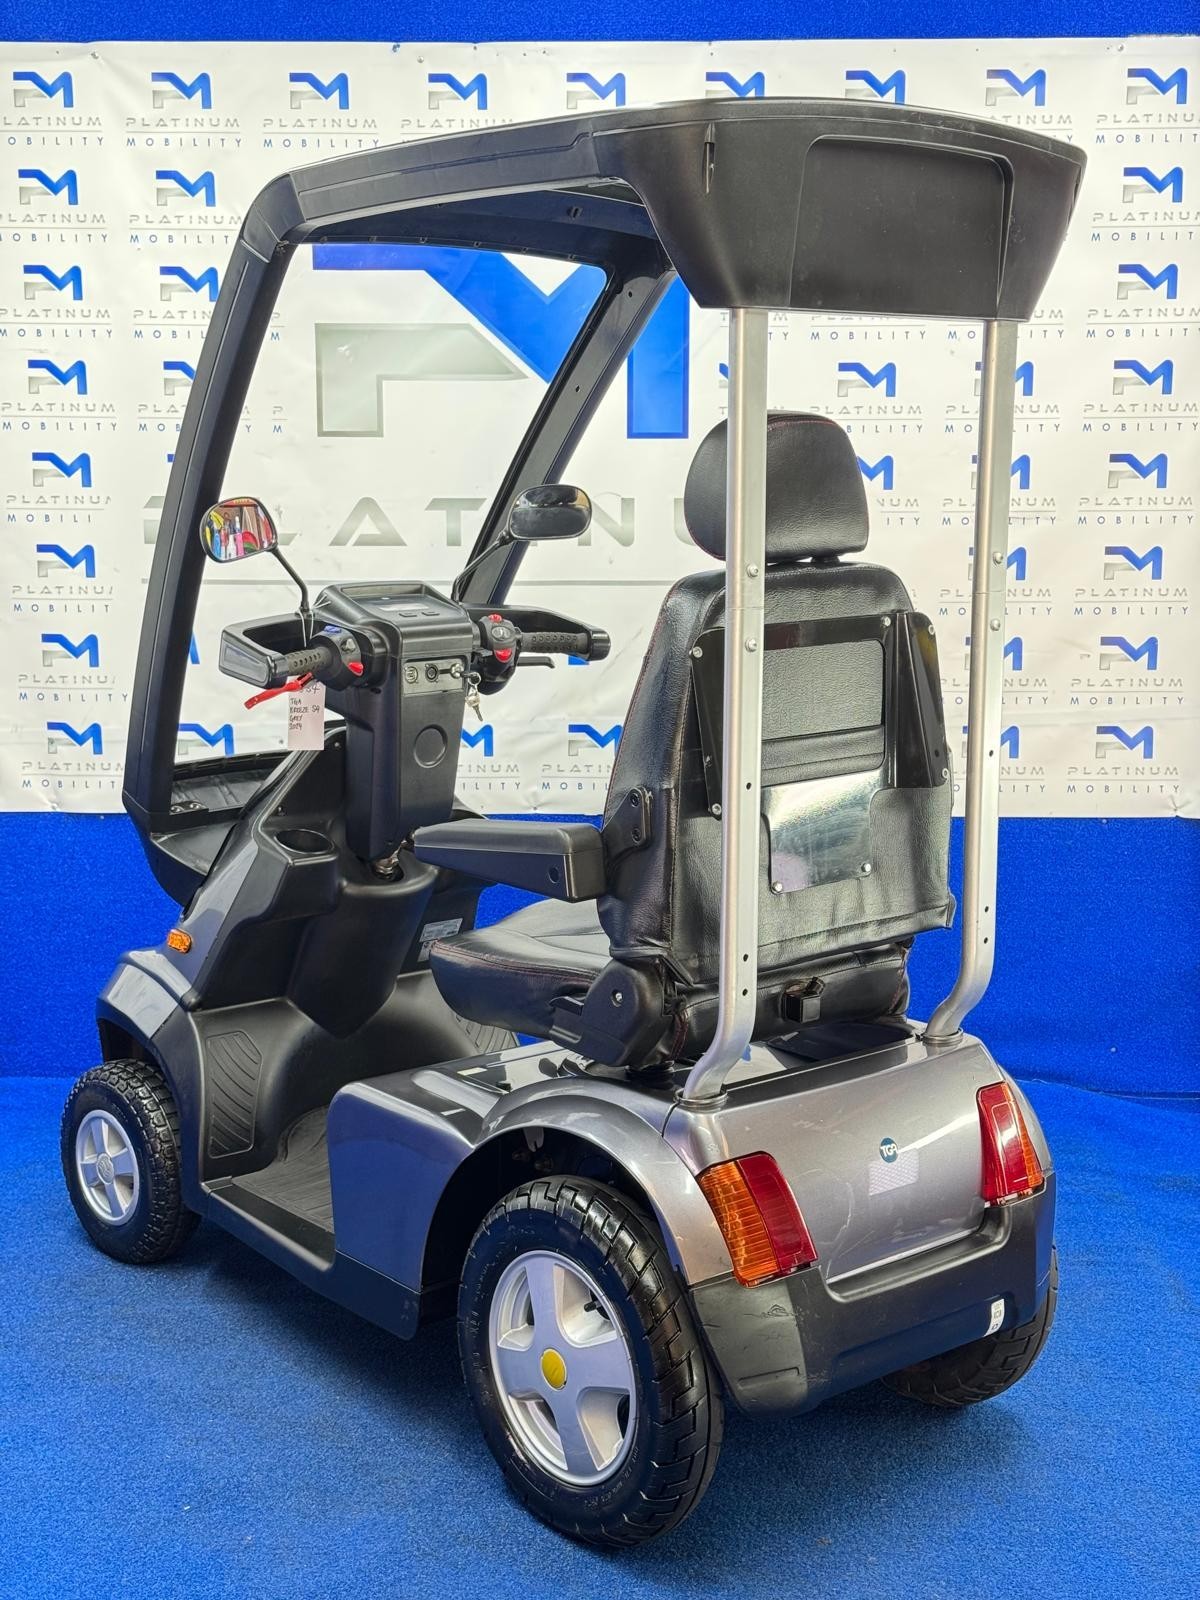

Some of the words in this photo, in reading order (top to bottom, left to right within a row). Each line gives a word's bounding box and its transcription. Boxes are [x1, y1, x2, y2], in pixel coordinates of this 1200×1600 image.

[3, 116, 102, 126] LATINUM
[126, 118, 240, 128] PLATINUM
[1097, 113, 1200, 123] PLATINU
[263, 119, 378, 129] PLATINUM
[8, 136, 103, 146] OBILITY
[126, 138, 242, 148] MOBILITY
[264, 138, 380, 148] MOBILITY
[1096, 133, 1198, 143] MOBILIT
[0, 213, 106, 223] LATINUM
[0, 233, 107, 243] OBILITY
[129, 234, 231, 244] MOBILIT
[1091, 231, 1193, 241] MOBILIT
[133, 310, 211, 319] PLATIN
[134, 330, 205, 339] MOBIL
[811, 331, 925, 340] MOBILITY
[1086, 328, 1200, 338] MOBILIT
[1, 402, 115, 413] PLATINUM
[1083, 403, 1198, 413] PLATINUM
[2, 421, 117, 431] MOBILITY
[846, 424, 923, 433] BILITY
[1083, 423, 1199, 432] MOBILITY
[1079, 496, 1193, 506] PLATINUM
[1078, 516, 1194, 525] MOBILITY
[12, 585, 113, 595] PLATINU
[1075, 587, 1188, 597] PLATINUM
[1074, 606, 1189, 616] MOBILITY
[18, 674, 115, 684] PLATINU
[1071, 677, 1184, 687] PLATINUM
[19, 693, 128, 702] MOBILITY
[1070, 696, 1185, 706] MOBILITY
[1067, 765, 1180, 776] PLATINUM
[22, 779, 115, 789] MOBILIT
[1067, 784, 1180, 793] MOBILITY
